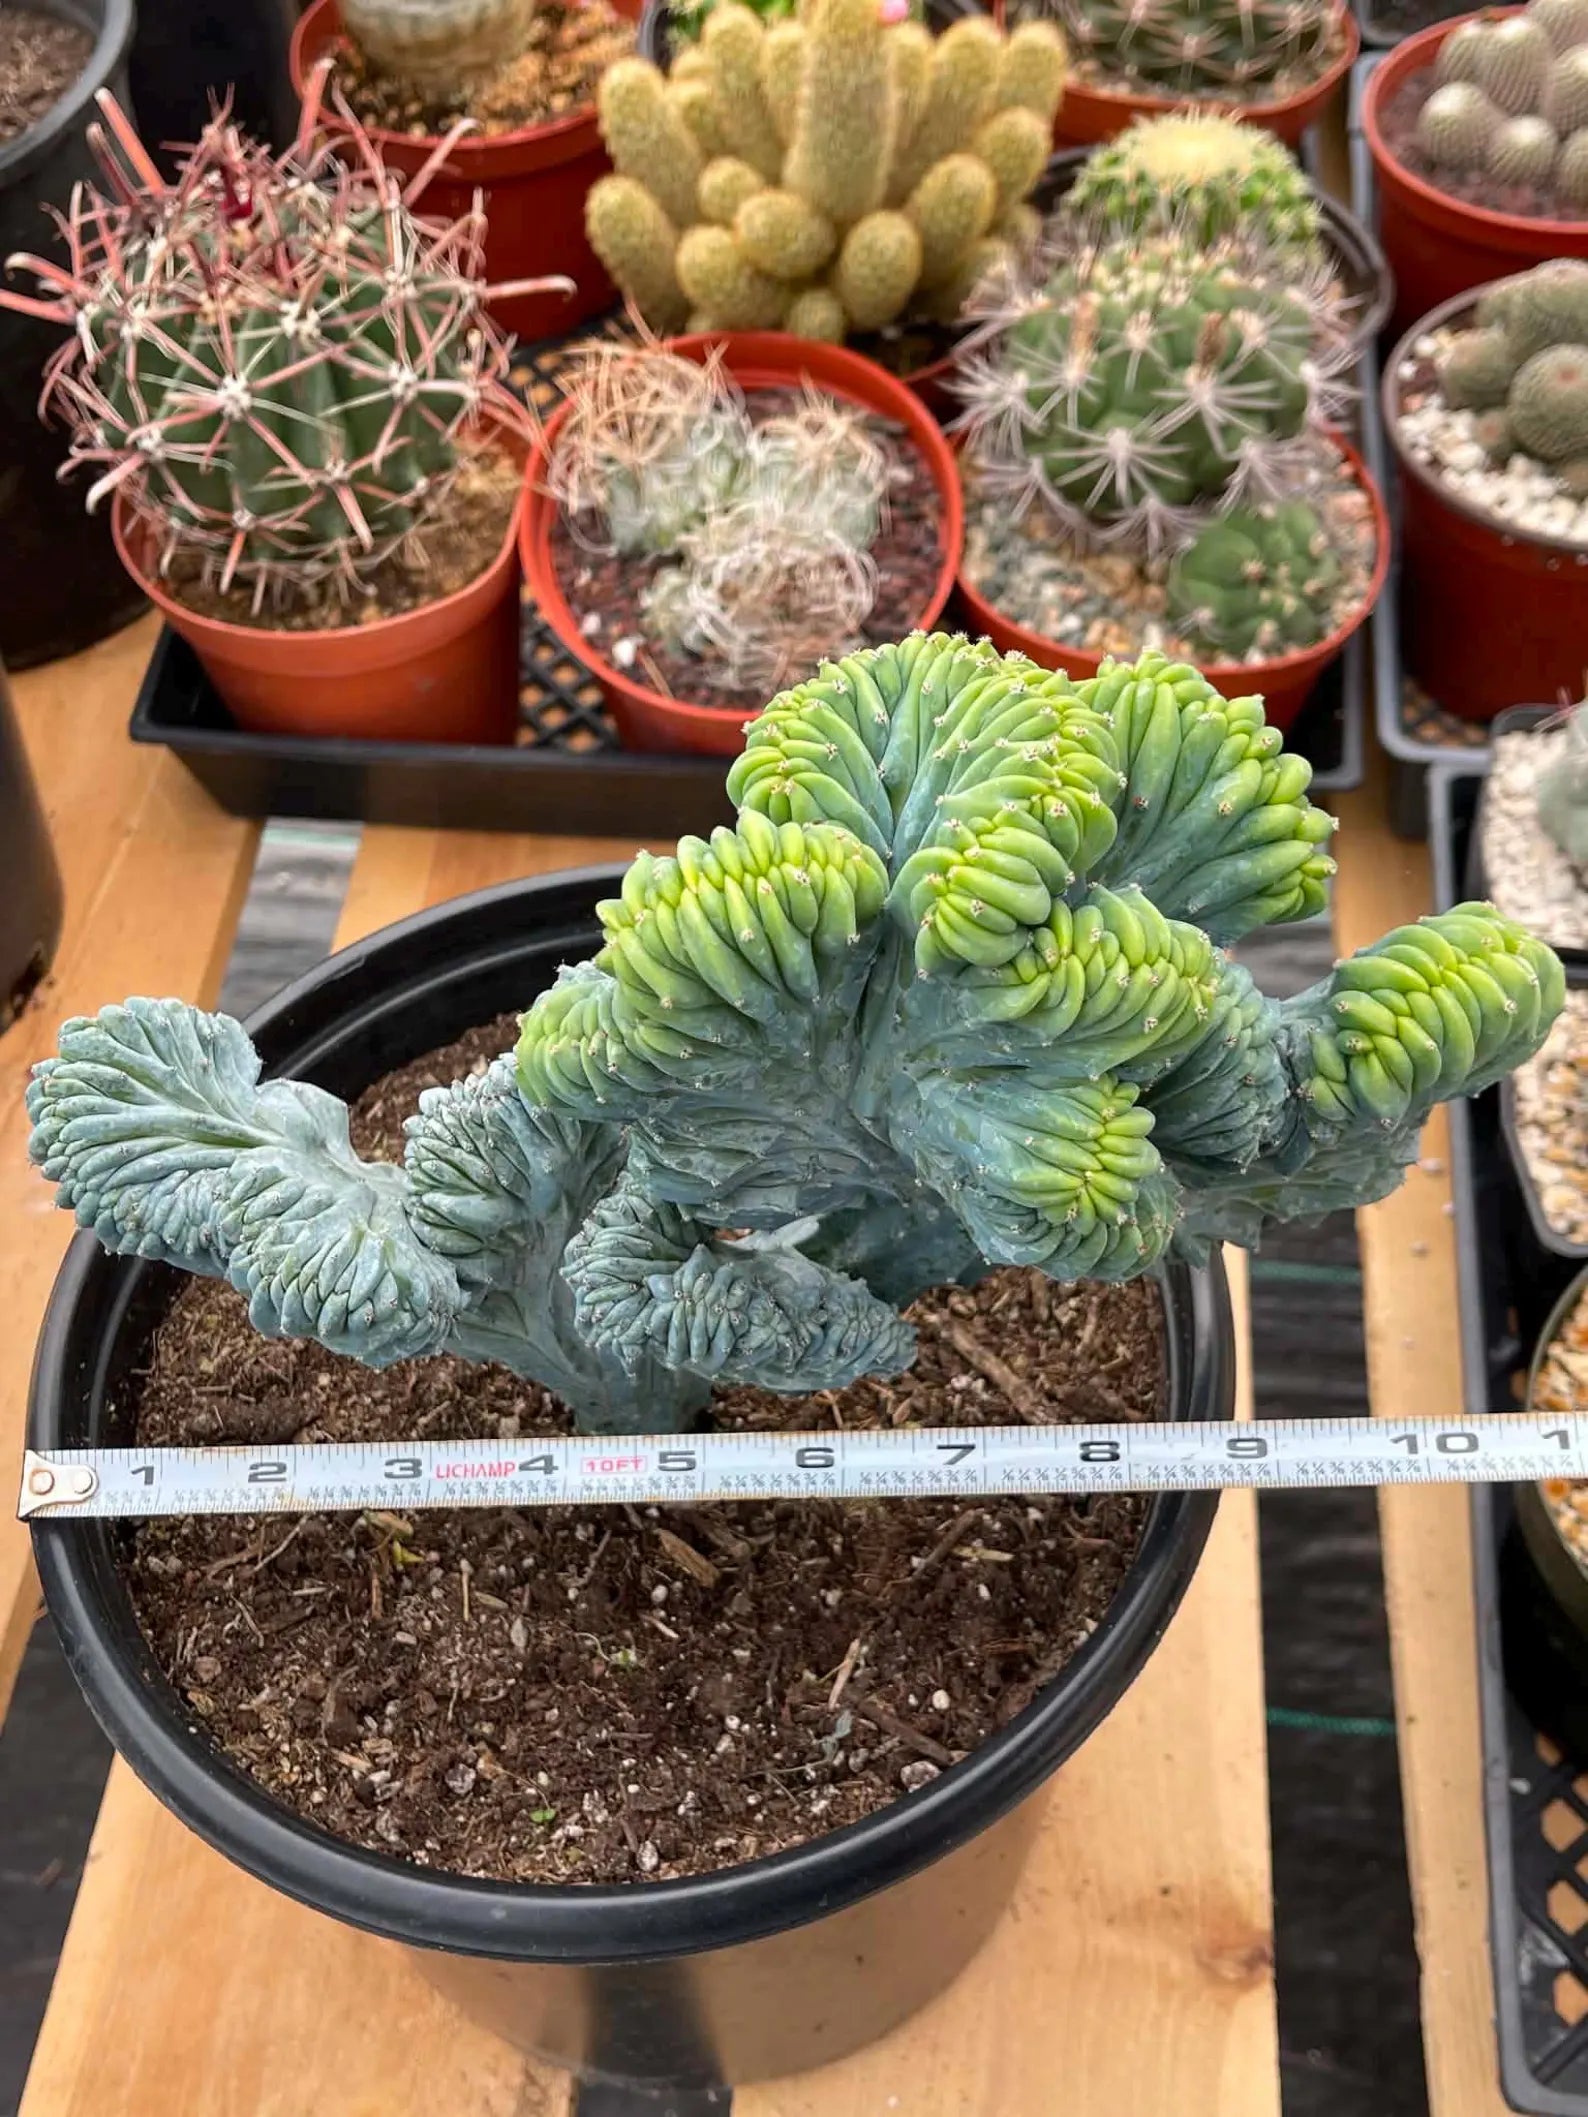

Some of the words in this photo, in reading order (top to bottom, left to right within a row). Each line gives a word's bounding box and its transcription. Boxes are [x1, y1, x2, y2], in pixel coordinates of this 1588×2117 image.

[131, 1465, 155, 1485] 1
[247, 1462, 288, 1482] 2
[384, 1458, 423, 1479] 3
[518, 1454, 559, 1475] 4
[585, 1458, 644, 1473] 10FT
[657, 1450, 697, 1472] 5
[795, 1447, 835, 1468] 6
[936, 1444, 976, 1465] 7
[1079, 1441, 1121, 1462] 8
[1226, 1438, 1268, 1459] 9
[1390, 1432, 1480, 1455] 10
